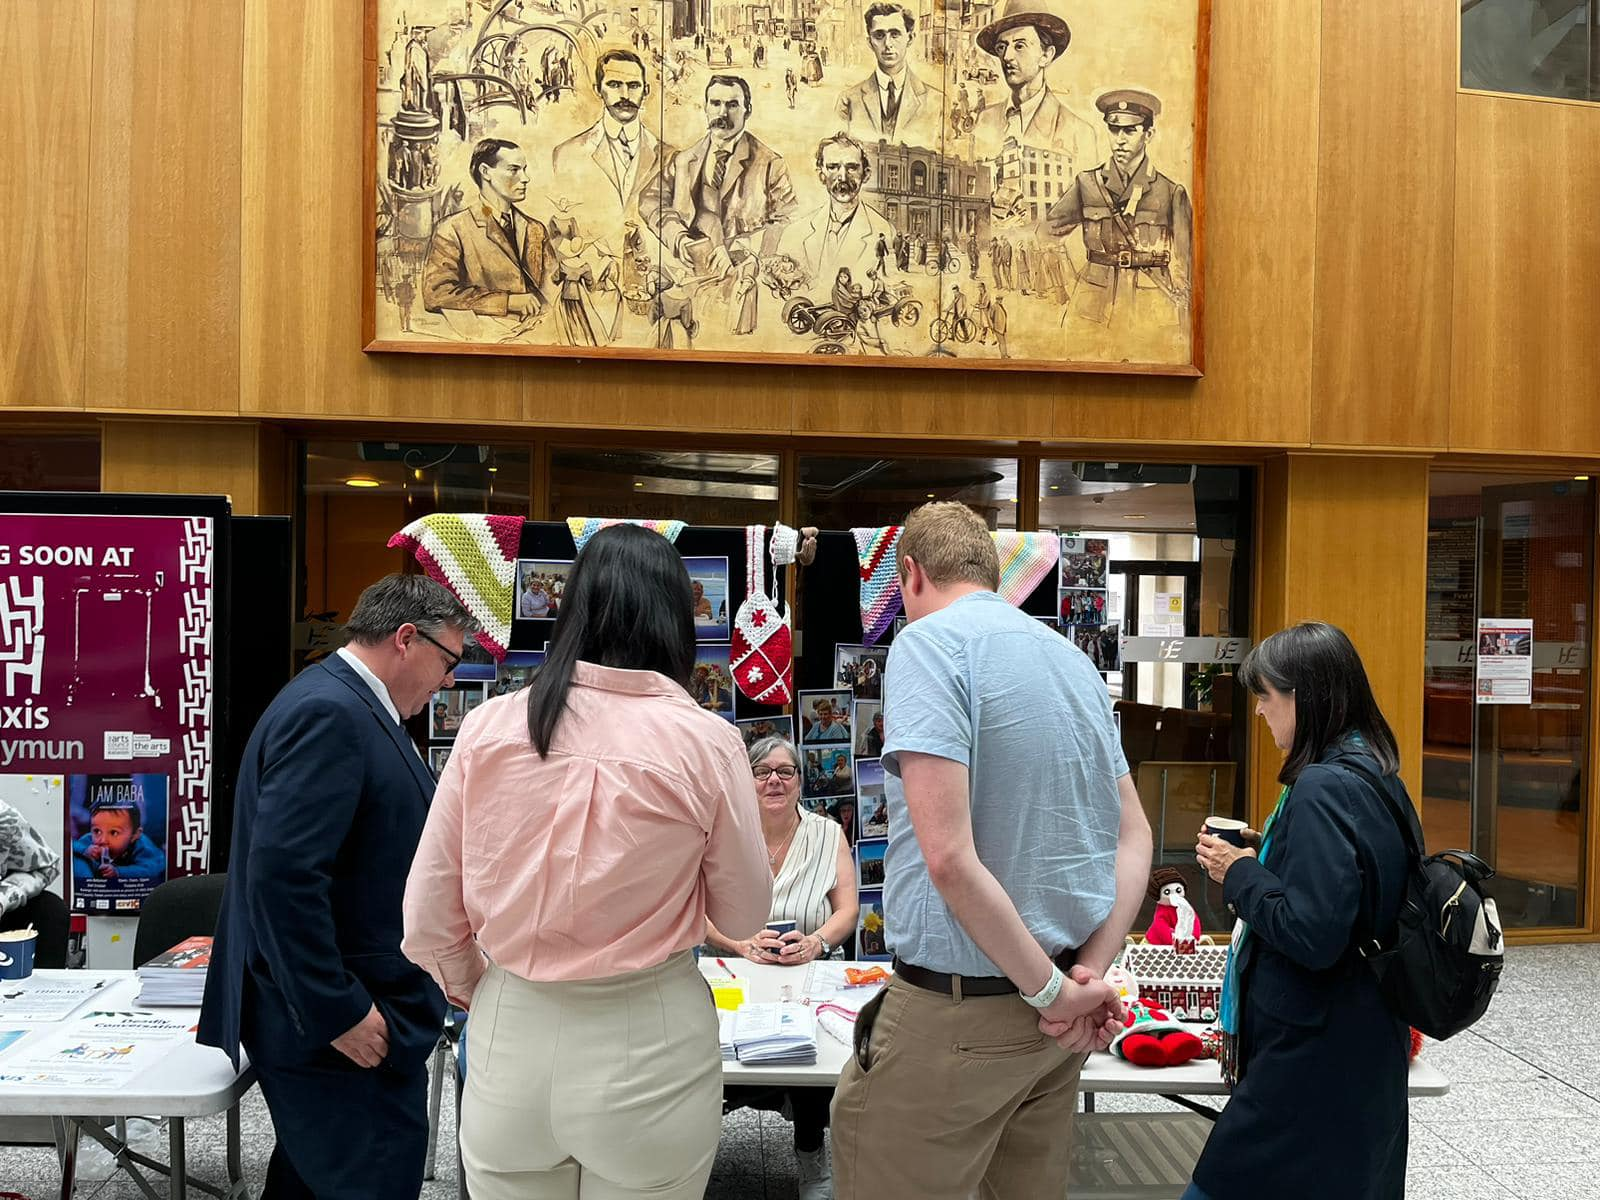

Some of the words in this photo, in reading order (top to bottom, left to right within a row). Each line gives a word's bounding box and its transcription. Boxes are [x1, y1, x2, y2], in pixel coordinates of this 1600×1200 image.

[19, 545, 94, 566] SOON
[101, 547, 135, 567] AT
[0, 697, 50, 730] xis
[0, 739, 84, 766] ymun
[134, 742, 150, 750] the
[150, 743, 168, 751] arts
[97, 785, 114, 802] AM
[116, 785, 145, 802] BABA
